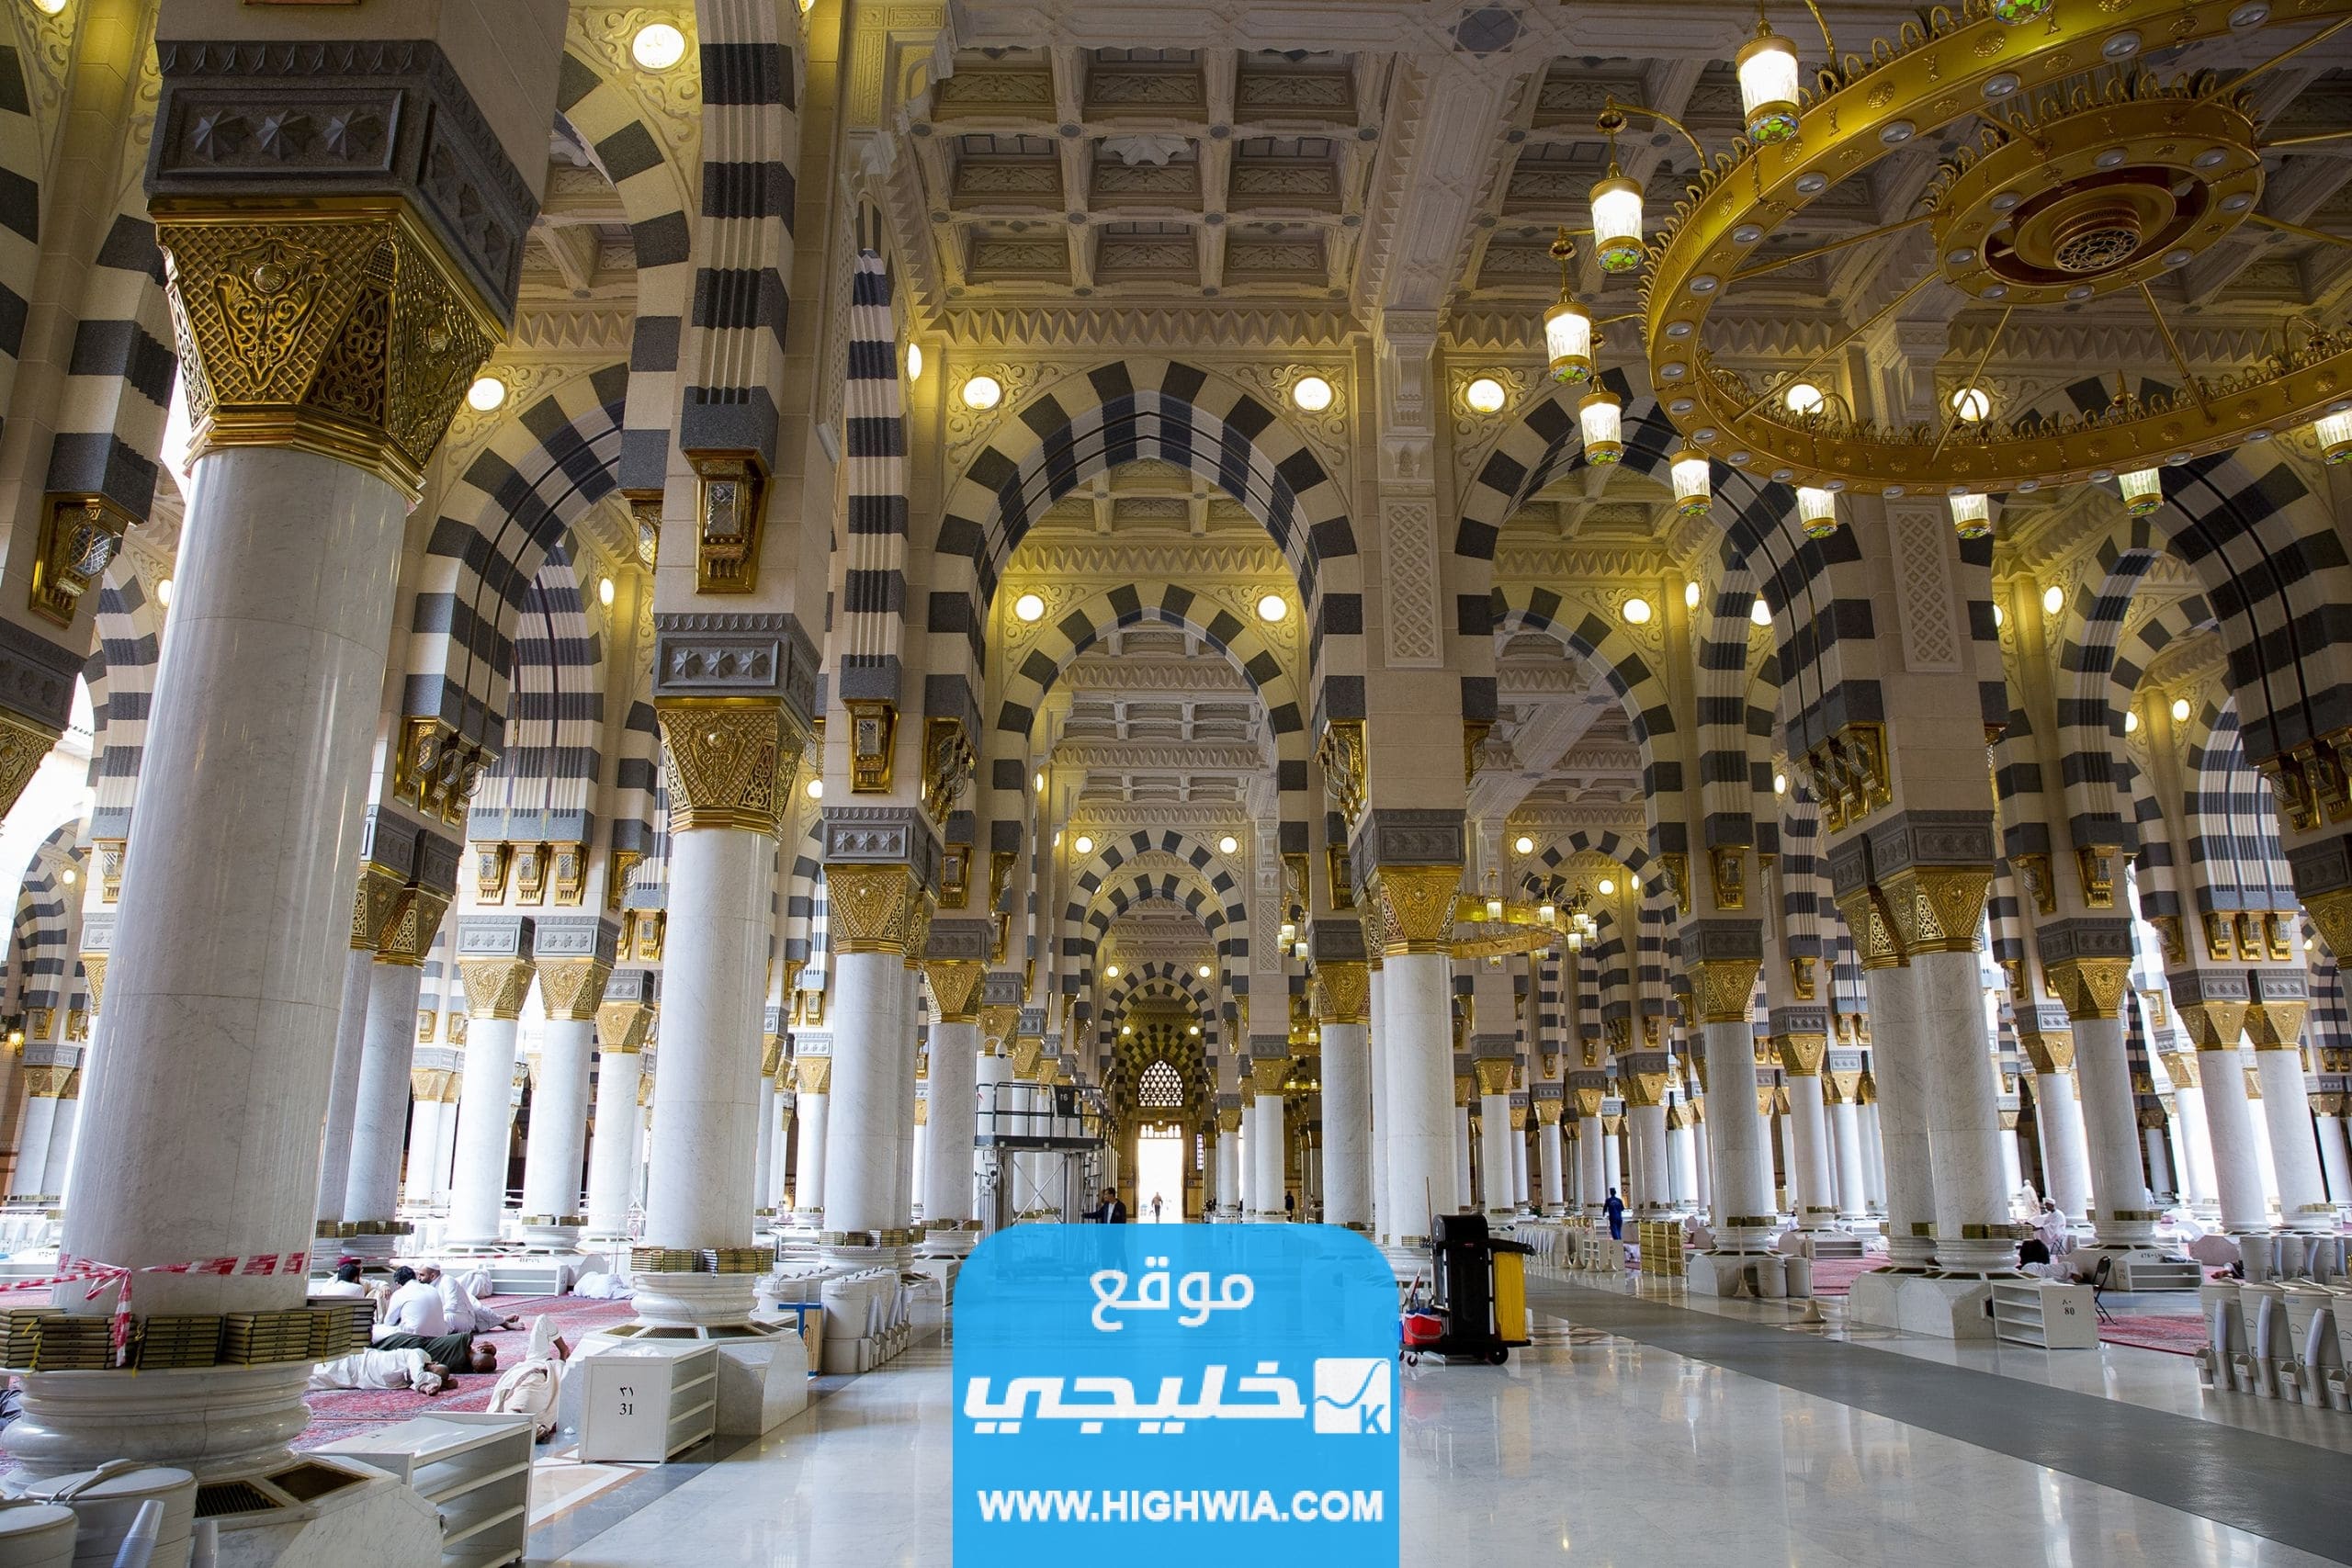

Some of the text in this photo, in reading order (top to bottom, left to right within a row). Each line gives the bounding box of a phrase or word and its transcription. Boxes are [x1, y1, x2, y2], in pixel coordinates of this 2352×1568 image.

[2064, 1306, 2075, 1315] 80
[619, 1386, 634, 1397] ٣١
[619, 1403, 633, 1416] 31
